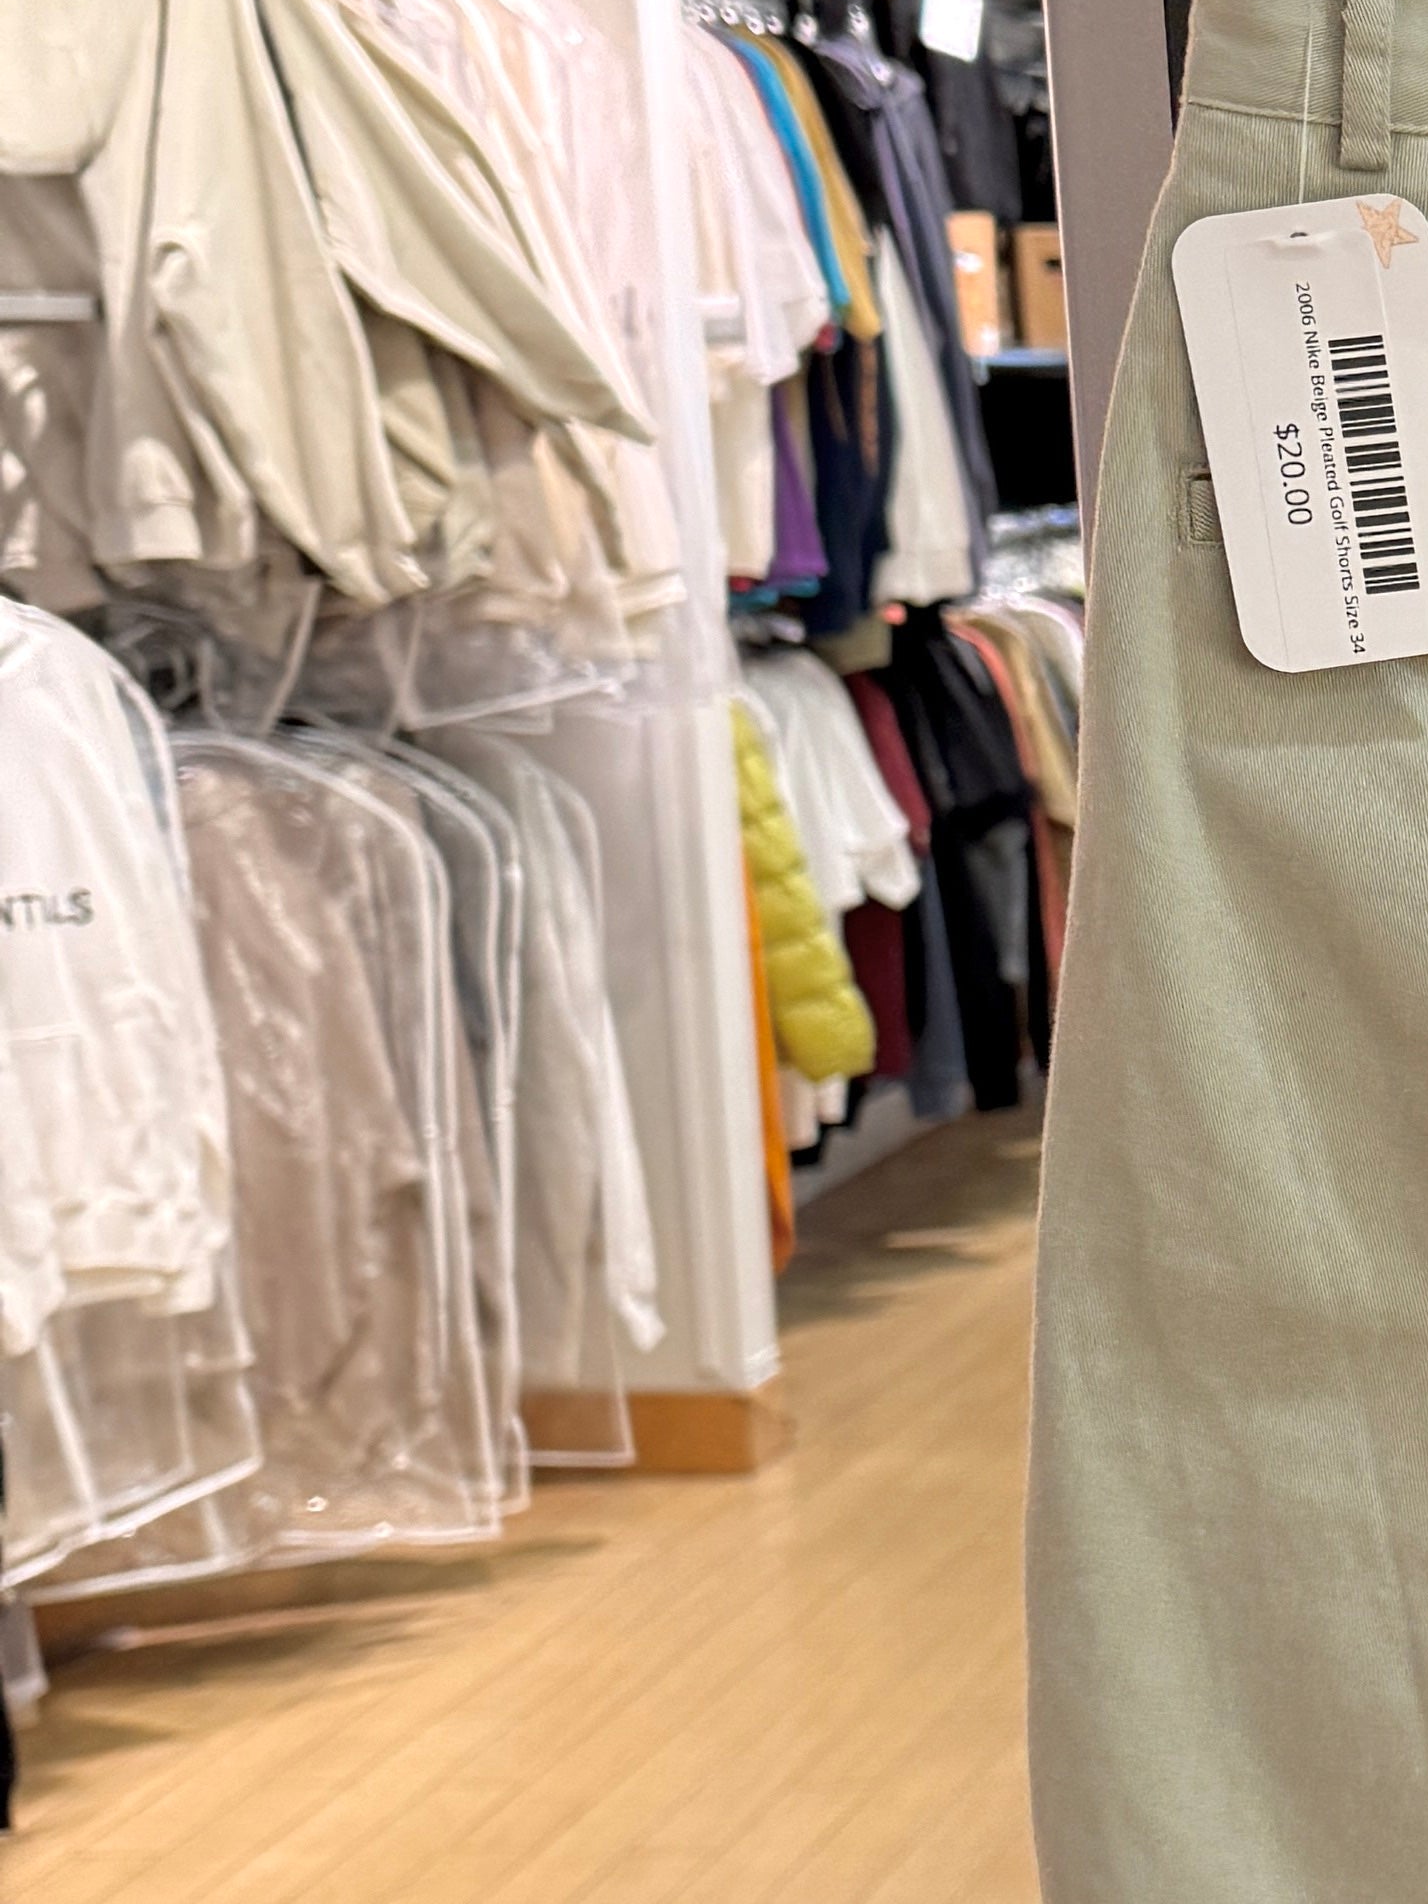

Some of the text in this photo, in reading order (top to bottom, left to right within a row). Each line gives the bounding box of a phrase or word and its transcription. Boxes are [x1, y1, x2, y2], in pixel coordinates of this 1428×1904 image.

[1272, 422, 1313, 525] $20.00
[1295, 281, 1366, 654] 2006 Nike Beige Pleated Golf Shorts Size 34
